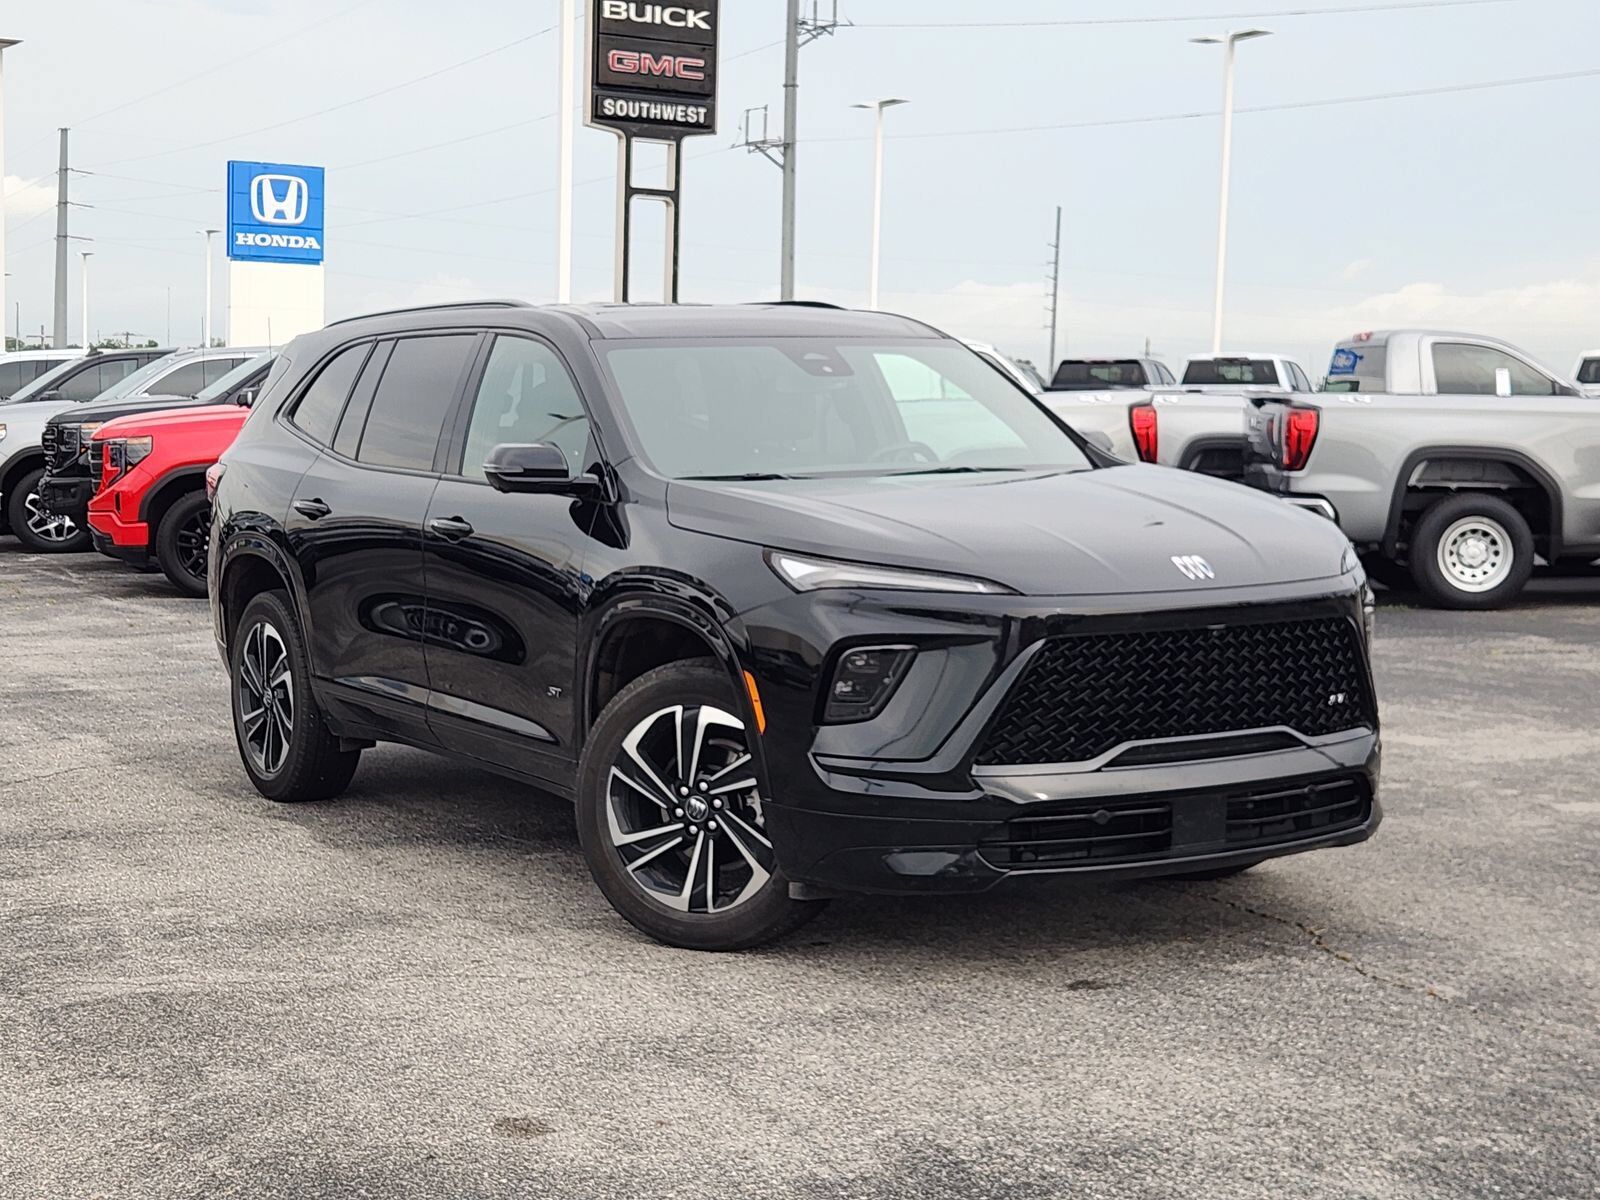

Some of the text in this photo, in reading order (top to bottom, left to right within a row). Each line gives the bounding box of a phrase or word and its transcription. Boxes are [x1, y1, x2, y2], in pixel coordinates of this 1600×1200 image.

[602, 0, 711, 29] BUICK
[608, 50, 705, 80] GMC
[603, 98, 708, 124] SOUTHWEST
[235, 232, 320, 249] HONDA
